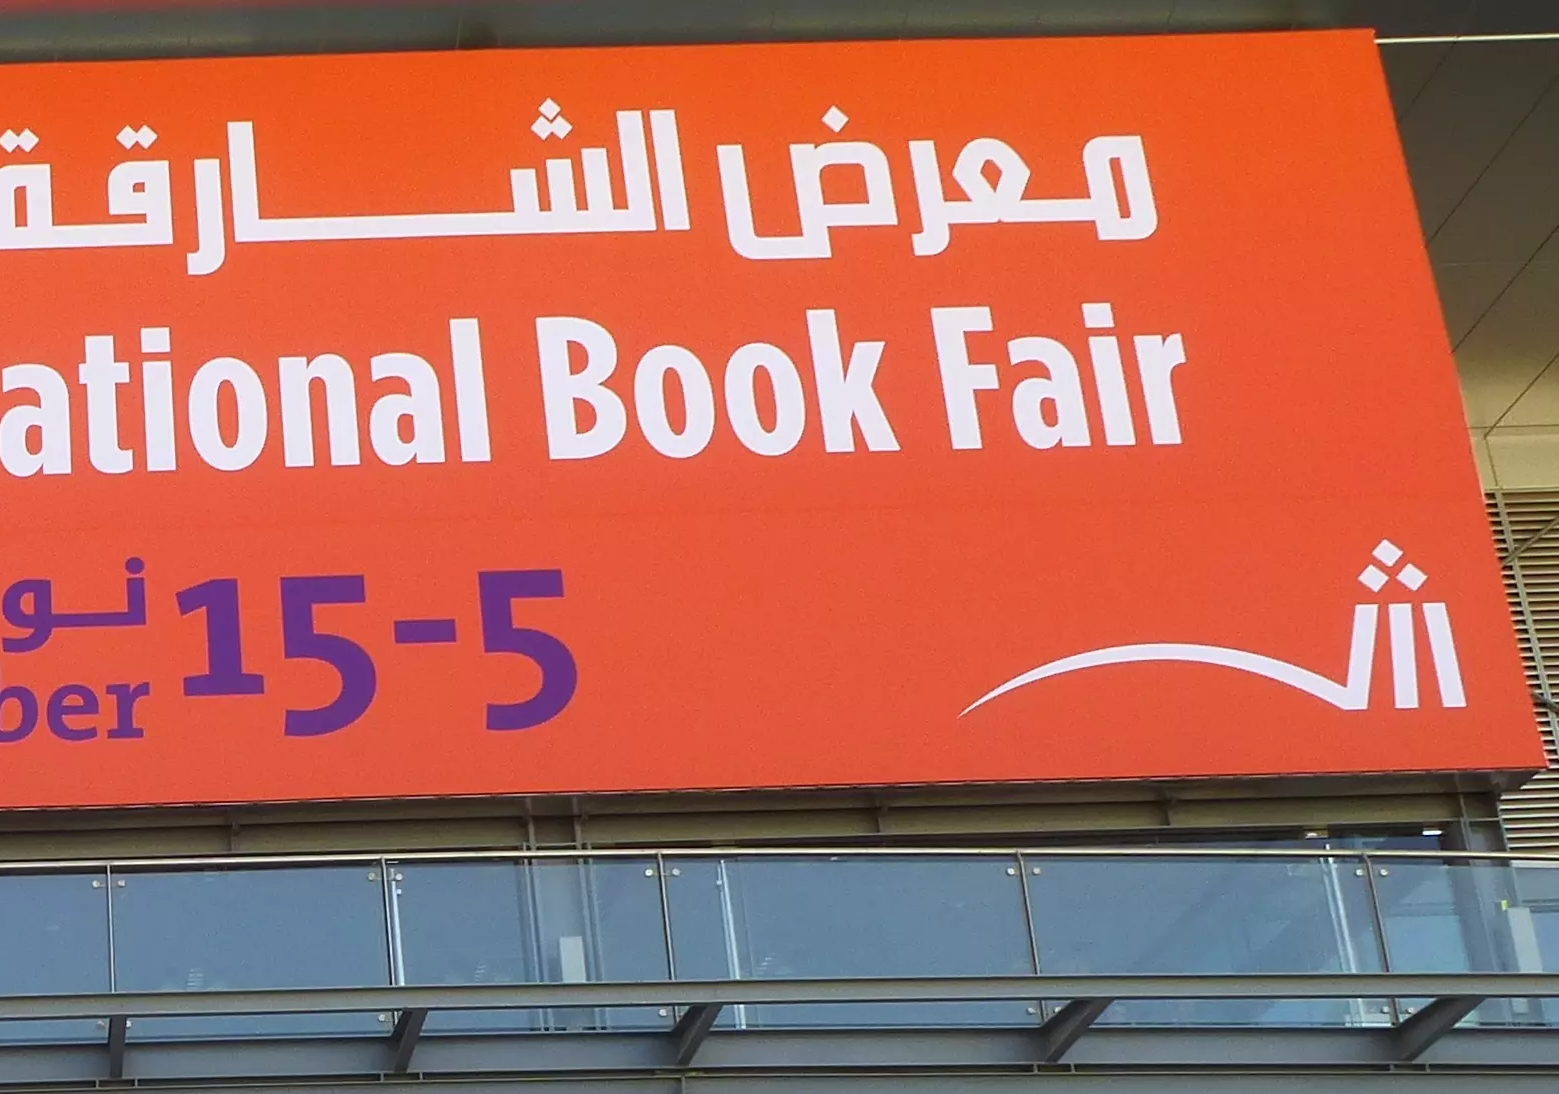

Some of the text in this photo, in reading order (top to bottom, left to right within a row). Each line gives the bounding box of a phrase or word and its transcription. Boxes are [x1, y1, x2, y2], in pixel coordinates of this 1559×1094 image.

[716, 106, 1158, 260] معرض
[535, 308, 901, 460] Book
[930, 302, 1186, 450] Fair
[176, 571, 578, 737] 15-5
